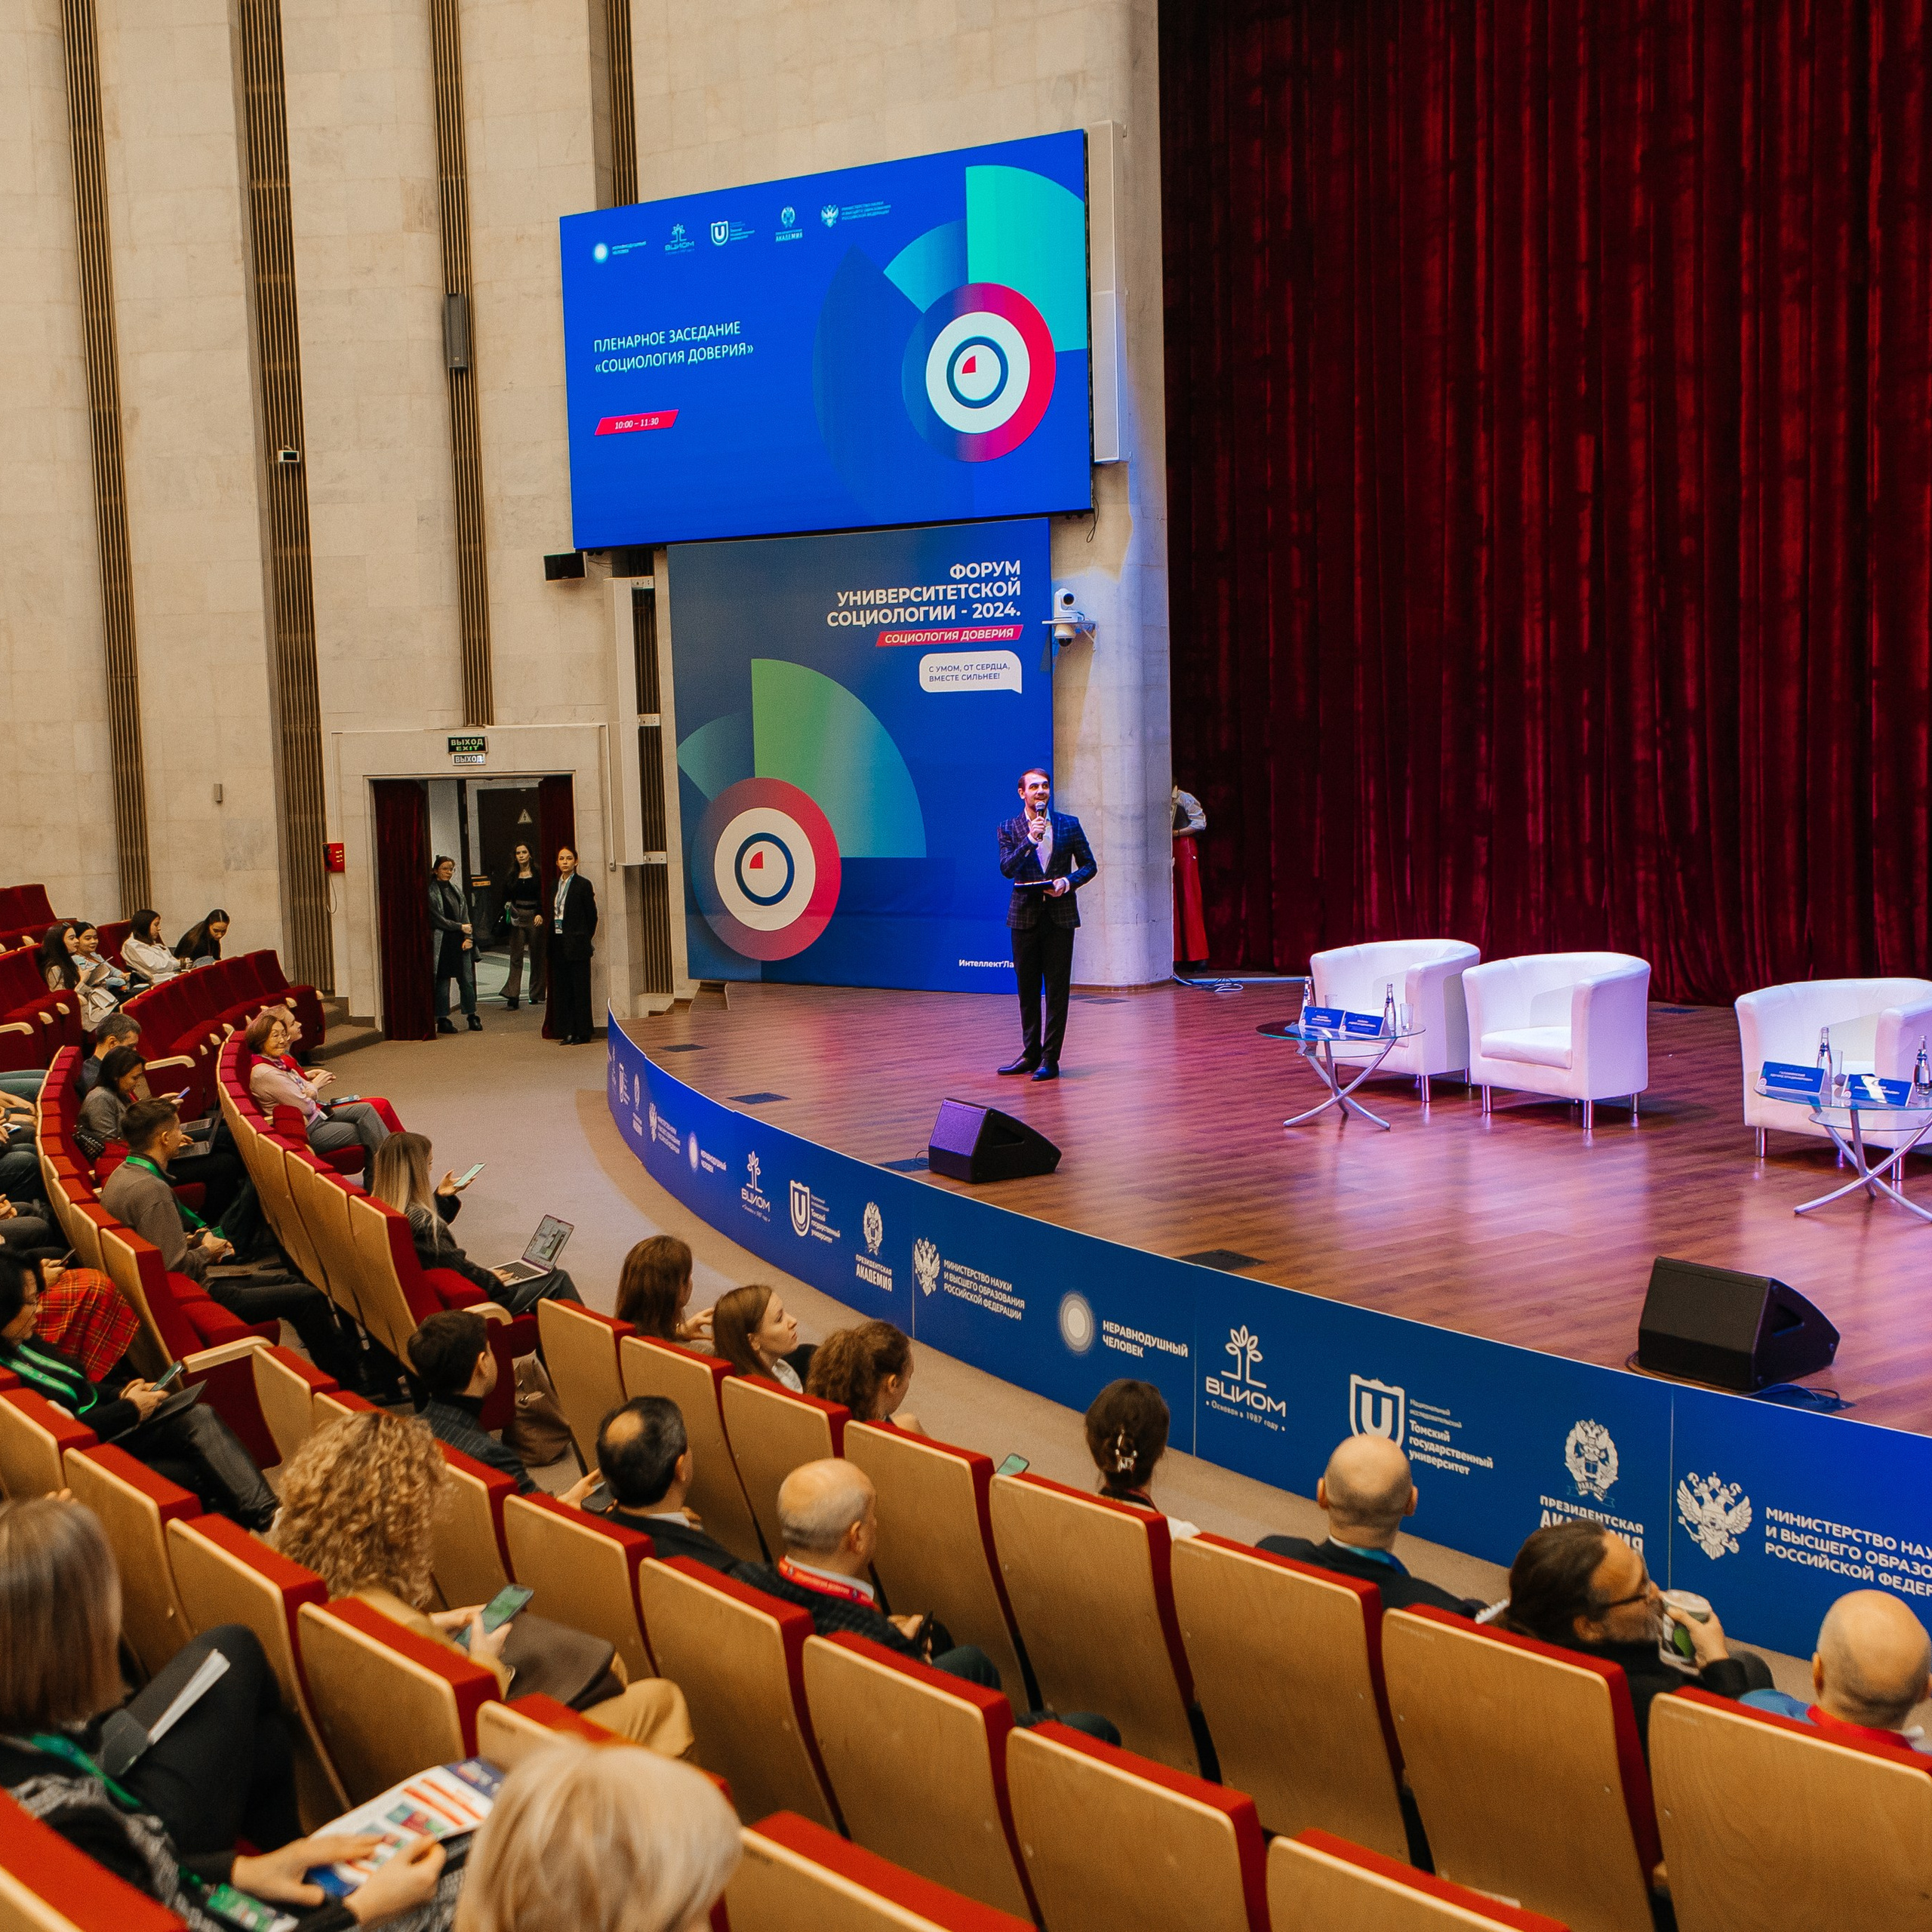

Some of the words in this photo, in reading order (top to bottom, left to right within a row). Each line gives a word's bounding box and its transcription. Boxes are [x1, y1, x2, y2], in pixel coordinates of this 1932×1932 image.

[594, 331, 666, 352] ПЛЕНАРНОЕ
[669, 321, 740, 342] ЗАСЕДАНИЕ
[595, 350, 685, 373] «СОЦИОЛОГИЯ
[688, 343, 754, 365] ДОВЕРИЯ»
[614, 420, 633, 429] 10:00
[640, 417, 660, 427] 11:30
[949, 560, 1020, 580] ФОРУМ
[837, 577, 1020, 607] УНИВЕРСИТЕТСКОЙ
[826, 605, 955, 628] СОЦИОЛОГИИ
[972, 601, 1021, 619] 2024.
[884, 630, 958, 644] СОЦИОЛОГИЯ
[960, 627, 1014, 641] ДОВЕРИЯ
[929, 674, 959, 682] ВМЕСТЕ
[961, 672, 1001, 681] СИЛЬНЕЕ!
[936, 665, 962, 673] УМОМ,
[976, 663, 1011, 671] СЕРДЦА,
[958, 959, 1014, 968] Интеллект'Ла
[741, 1187, 770, 1213] ВЦИОМ
[856, 1263, 892, 1292] АКАДЕМИЯ
[943, 1259, 990, 1284] МИНИСТЕРСТВО
[990, 1276, 1013, 1292] НАУКИ
[943, 1272, 949, 1281] И
[949, 1273, 978, 1291] ВЫСШЕГО
[978, 1284, 1025, 1309] ОБРАЗОВАНИЯ
[943, 1283, 982, 1306] РОССИЙСКОЙ
[983, 1298, 1022, 1321] ФЕДЕРАЦИИ
[1103, 1320, 1189, 1358] НЕРАВНОДУШНЫЙ
[1103, 1334, 1143, 1358] ЧЕЛОВЕК
[1206, 1376, 1286, 1417] ВЦИОМ
[1409, 1419, 1451, 1442] Томский
[1409, 1436, 1494, 1469] государственный
[1409, 1449, 1470, 1475] университет
[1540, 1494, 1644, 1535] ПРЕЗИДЕНТСКАЯ
[1765, 1507, 1897, 1551] МИНИСТЕРСТВО
[1765, 1524, 1777, 1539] И
[1780, 1528, 1862, 1560] ВЫСШЕГО
[1764, 1542, 1875, 1583] РОССИЙСКОЙ
